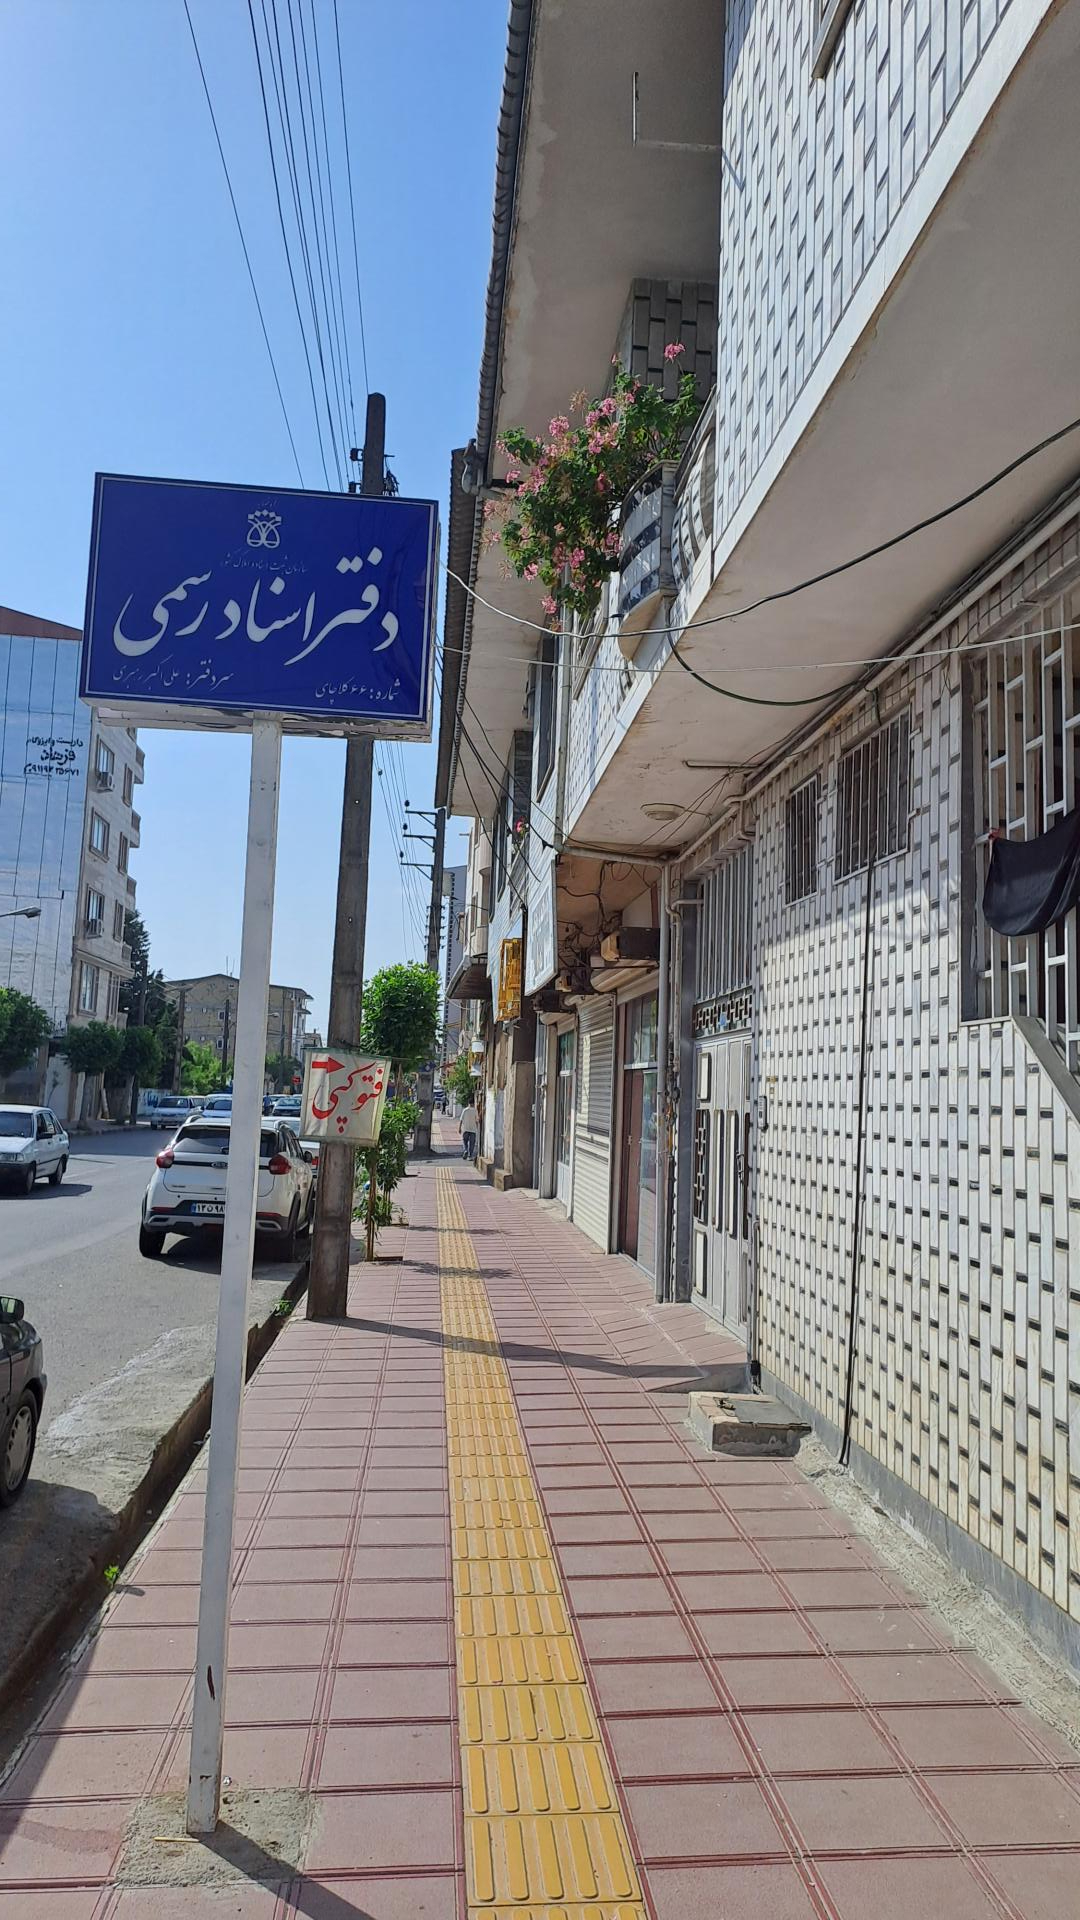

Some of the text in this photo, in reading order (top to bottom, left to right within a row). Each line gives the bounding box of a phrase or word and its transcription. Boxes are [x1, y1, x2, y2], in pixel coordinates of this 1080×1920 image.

[113, 547, 399, 666] دفتر اسناد رسمی
[163, 667, 179, 687] علی
